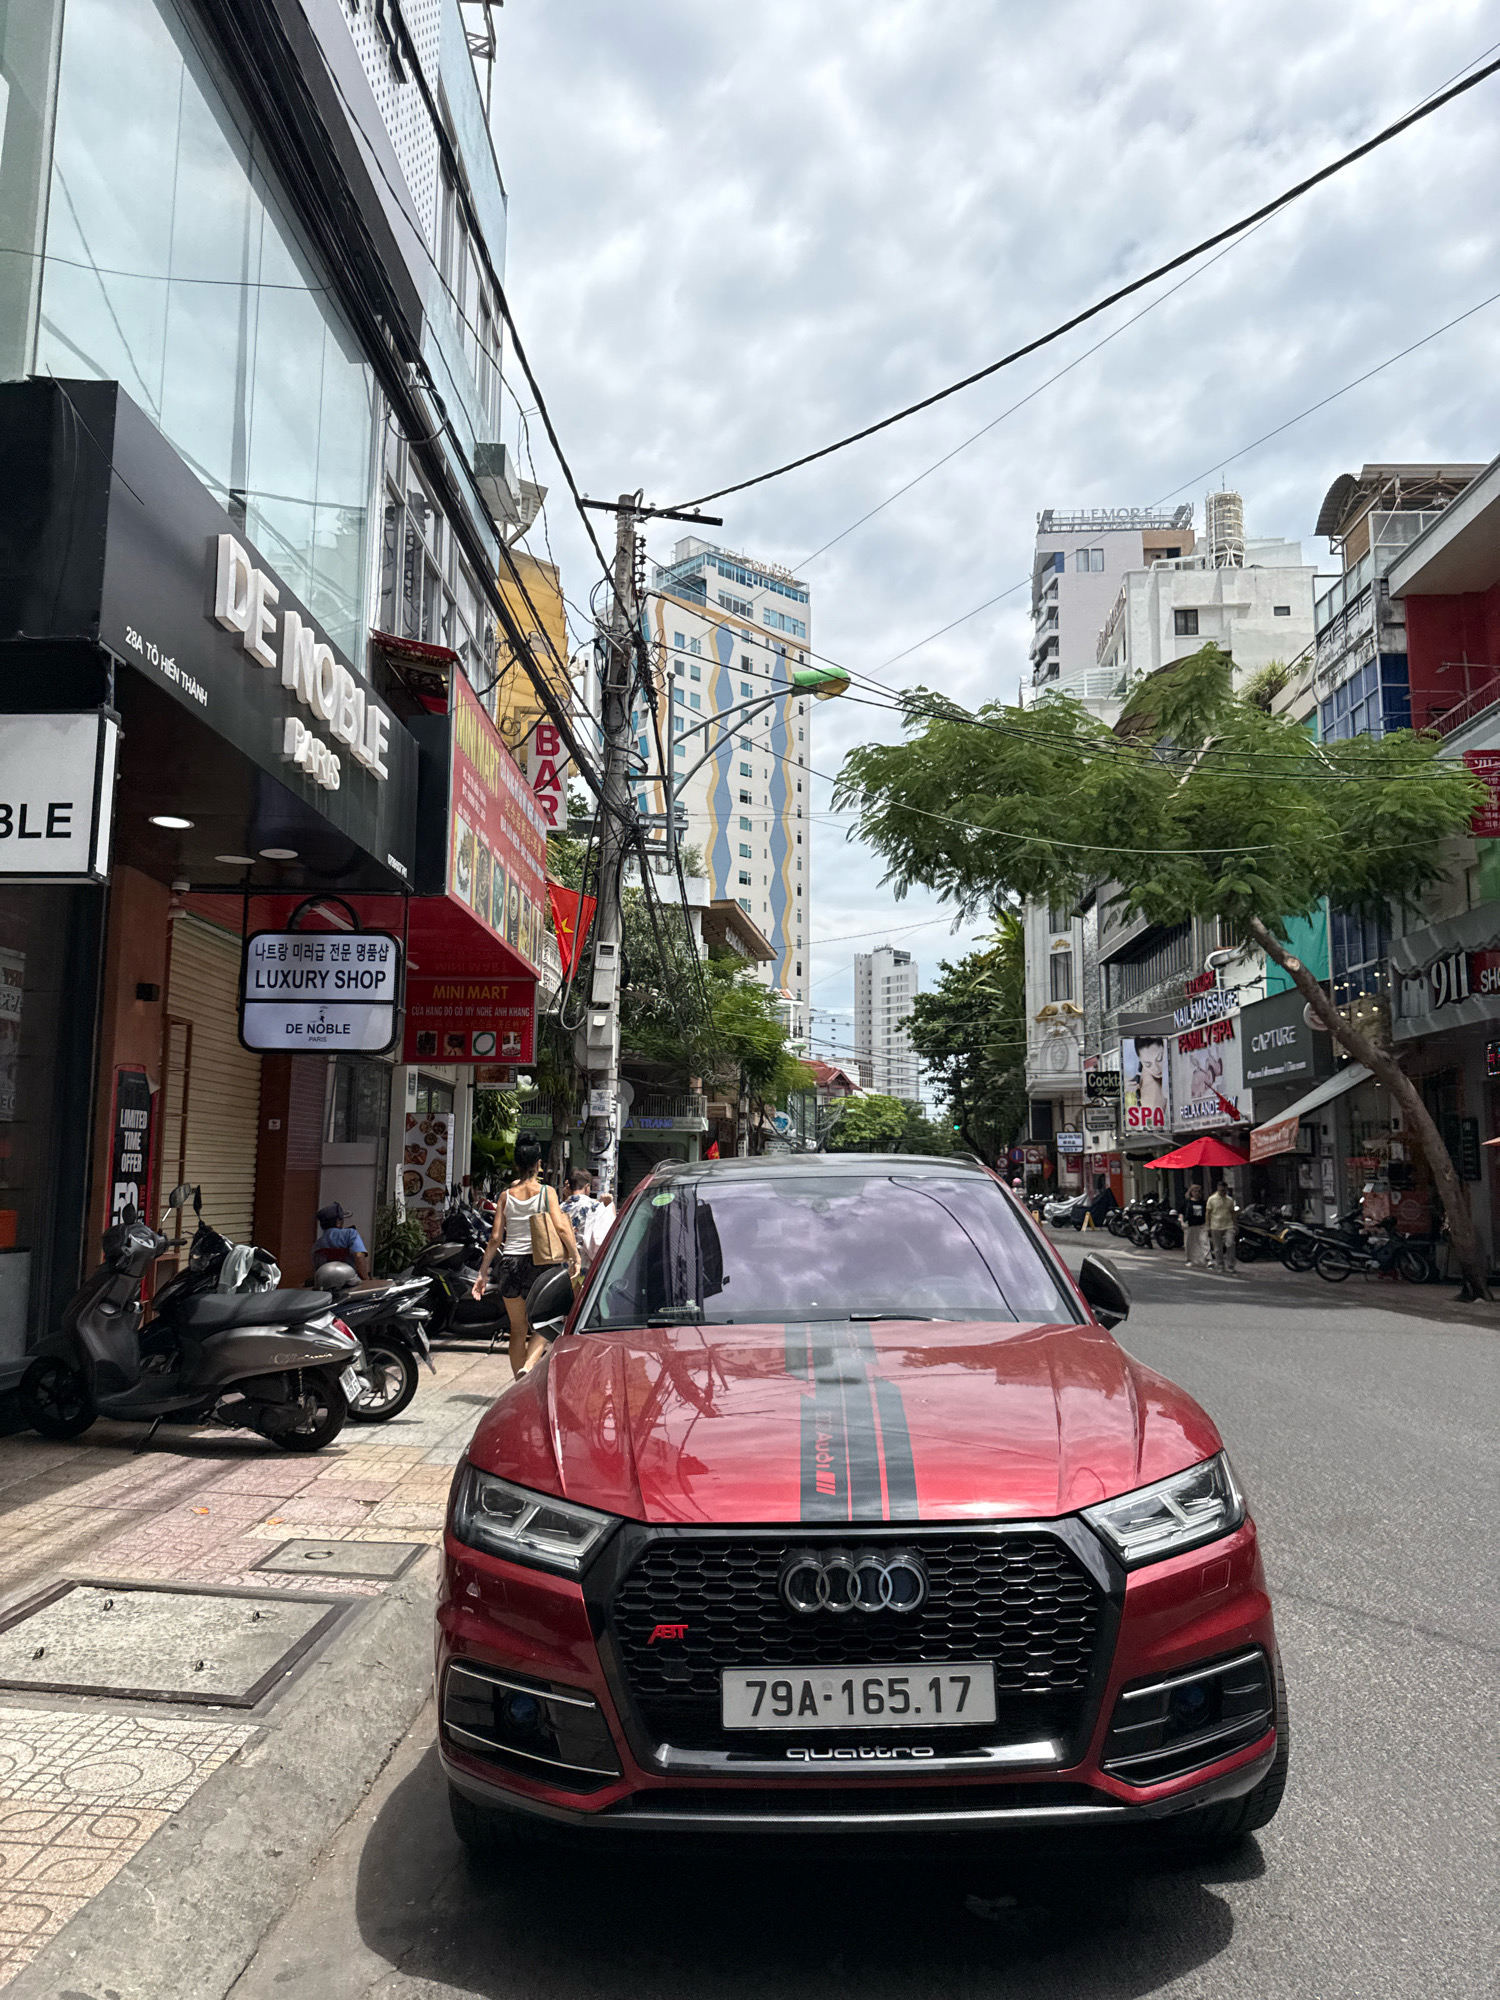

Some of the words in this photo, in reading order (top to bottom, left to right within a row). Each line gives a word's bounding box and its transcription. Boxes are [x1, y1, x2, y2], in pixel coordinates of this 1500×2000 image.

[125, 626, 143, 655] 28A
[146, 644, 159, 665] TÔ
[181, 671, 208, 706] THÀNH
[215, 534, 279, 668] DE
[281, 611, 390, 780] NOBLE
[284, 717, 341, 791] PARIS
[533, 724, 560, 827] BAR
[255, 942, 289, 961] 나트랑
[293, 942, 325, 961] 미러급
[330, 943, 352, 961] 전문
[356, 943, 390, 961] 명품샵
[255, 970, 330, 989] LUXURY
[334, 970, 387, 989] SHOP
[1431, 952, 1469, 1008] 911
[432, 985, 465, 999] MINI
[467, 985, 509, 1000] MART
[509, 1007, 530, 1017] KHANG
[1174, 1005, 1191, 1028] NAIL
[1195, 991, 1238, 1020] MASSAGE
[285, 1024, 303, 1034] DE
[306, 1024, 351, 1034] NOBLE
[1178, 1025, 1211, 1054] FAMILY
[1213, 1020, 1235, 1043] SPA
[1251, 1026, 1296, 1052] CAPTURE
[120, 1108, 147, 1129] LIMITED
[1128, 1107, 1164, 1126] SPA
[1180, 1103, 1201, 1119] RELAX
[638, 1118, 673, 1128] TRANG
[124, 1131, 141, 1150] TIME
[121, 1153, 142, 1172] OFFER
[814, 1431, 835, 1468] Audi
[647, 1624, 688, 1645] ABT
[745, 1675, 971, 1717] 79A-165.17
[786, 1746, 935, 1762] quattro
